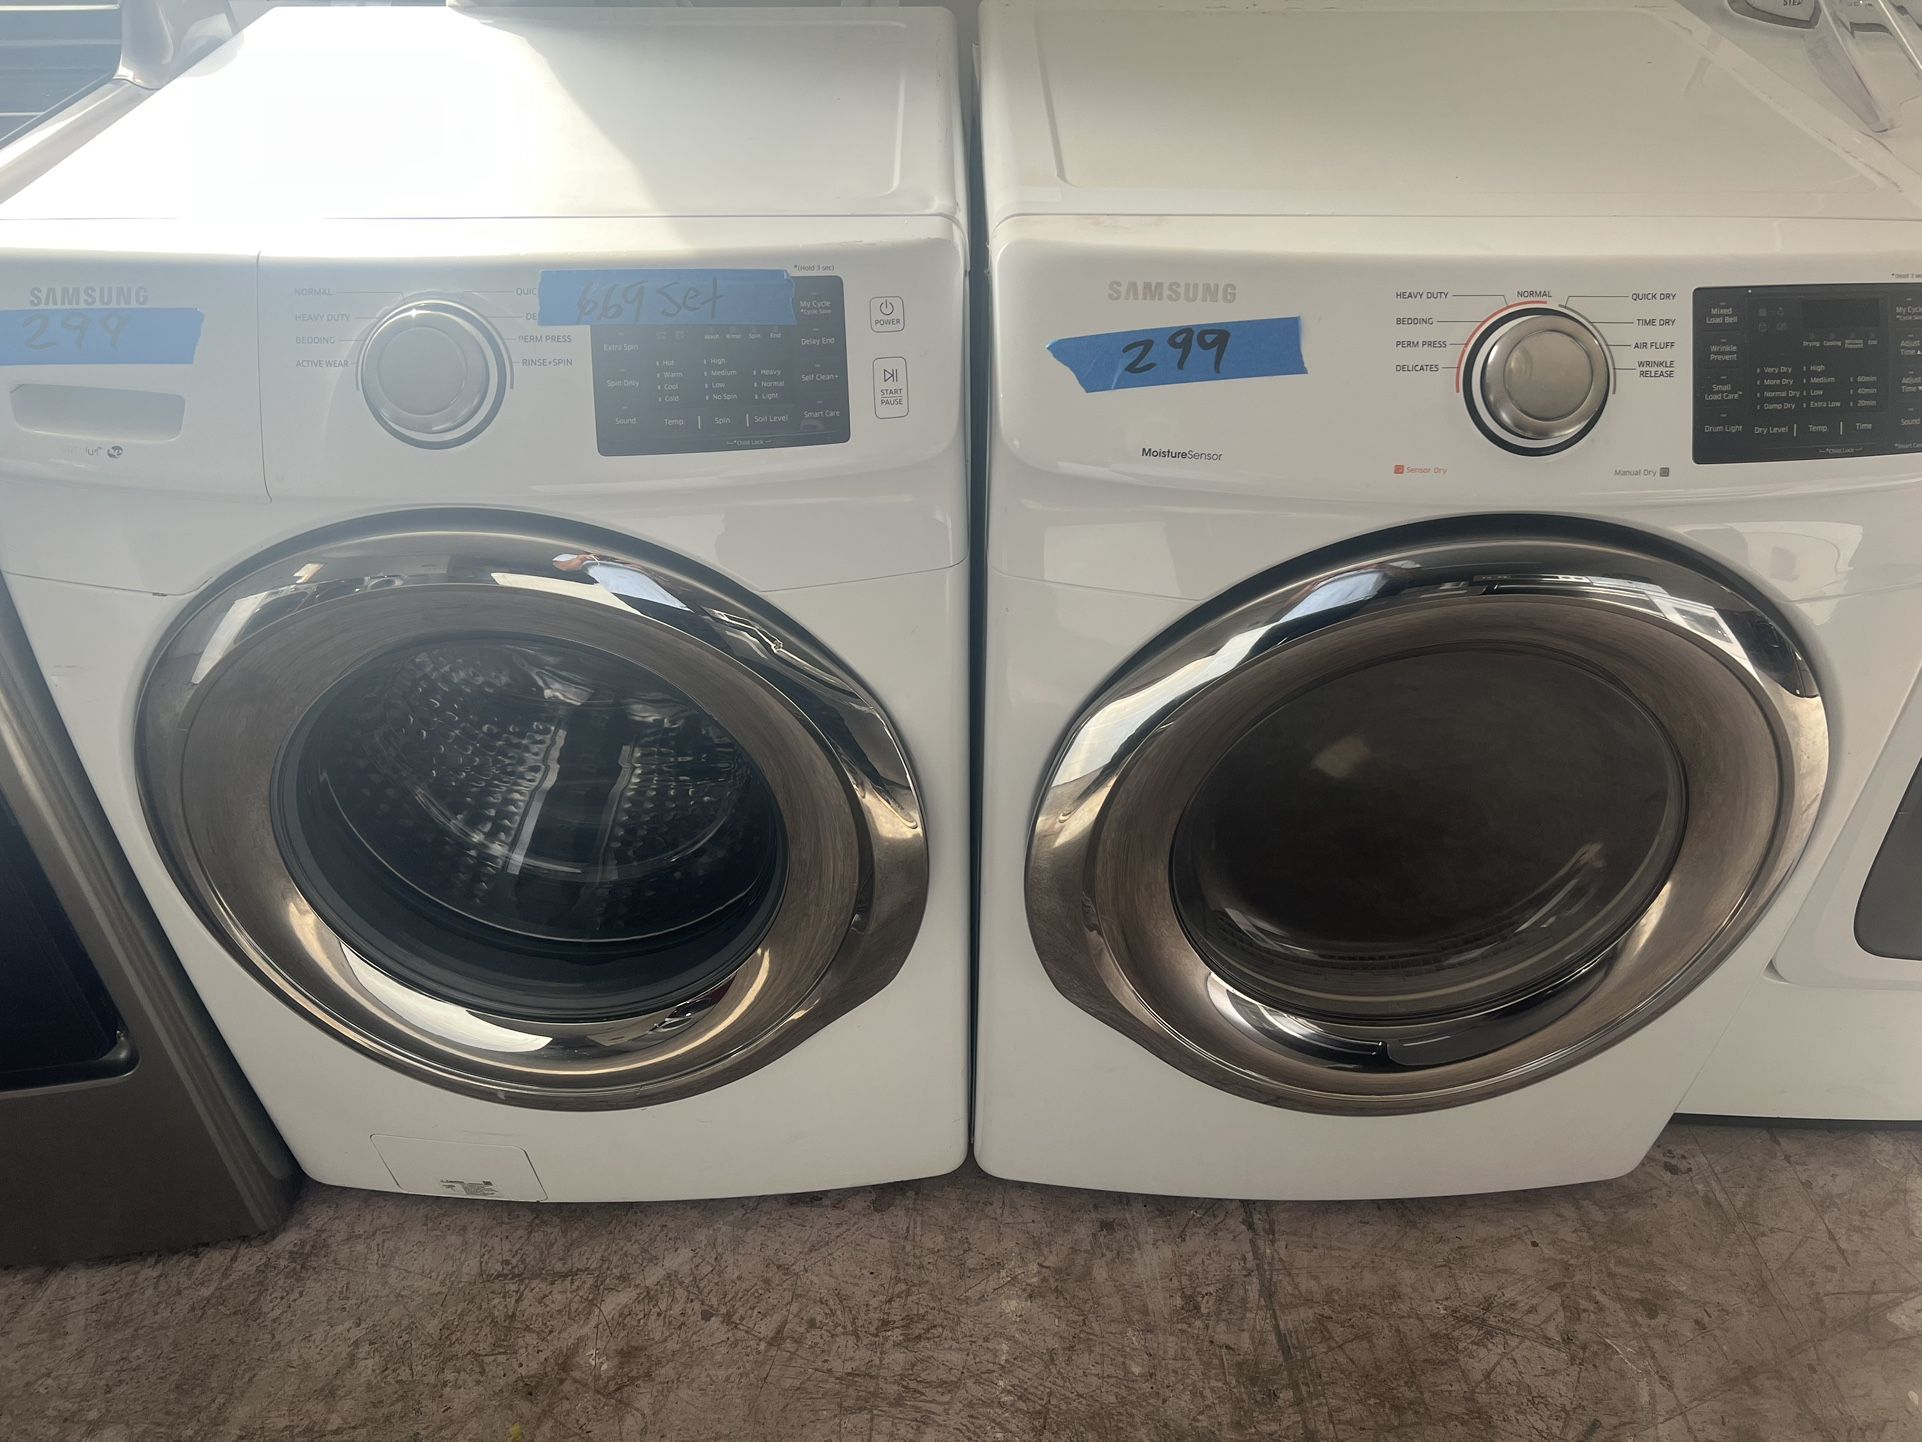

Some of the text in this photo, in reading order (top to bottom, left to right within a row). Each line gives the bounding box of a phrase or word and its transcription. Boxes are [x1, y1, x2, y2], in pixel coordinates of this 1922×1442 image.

[28, 286, 149, 306] SAMSUNG
[294, 288, 333, 297] NORMAL
[1108, 280, 1238, 304] SAMSUNG
[1396, 292, 1449, 300] HEAVY DUTY
[1516, 290, 1552, 298] NORMAL
[1631, 292, 1676, 301] QUICK DRY
[800, 300, 831, 309] My Cycle
[295, 312, 351, 322] HEAVY DUTY
[1396, 317, 1434, 325] BEDDING
[1636, 318, 1676, 326] TIME DRY
[295, 336, 336, 344] BEDDING
[518, 334, 572, 343] PERM PRESS
[801, 338, 820, 346] Delay
[623, 344, 639, 352] Spin
[1422, 340, 1448, 348] PRESS
[1634, 342, 1676, 350] AIR FLUFF
[1122, 326, 1232, 375] 299
[296, 360, 350, 368] ACTIVE WEAR
[760, 368, 782, 376] Heavy
[1764, 366, 1779, 374] Very
[801, 374, 814, 382] Self
[606, 379, 640, 388] Spin Only
[1764, 402, 1782, 410] Damp
[825, 410, 840, 418] Care
[616, 416, 638, 425] Sound
[714, 417, 731, 425] Spin
[754, 414, 788, 423] Soil Level
[1704, 424, 1743, 433] Drum Light
[1754, 426, 1788, 435] Dry Level
[1141, 448, 1223, 462] MoistureSensor
[1433, 466, 1448, 475] Dry
[1614, 468, 1657, 478] Manual Dry
